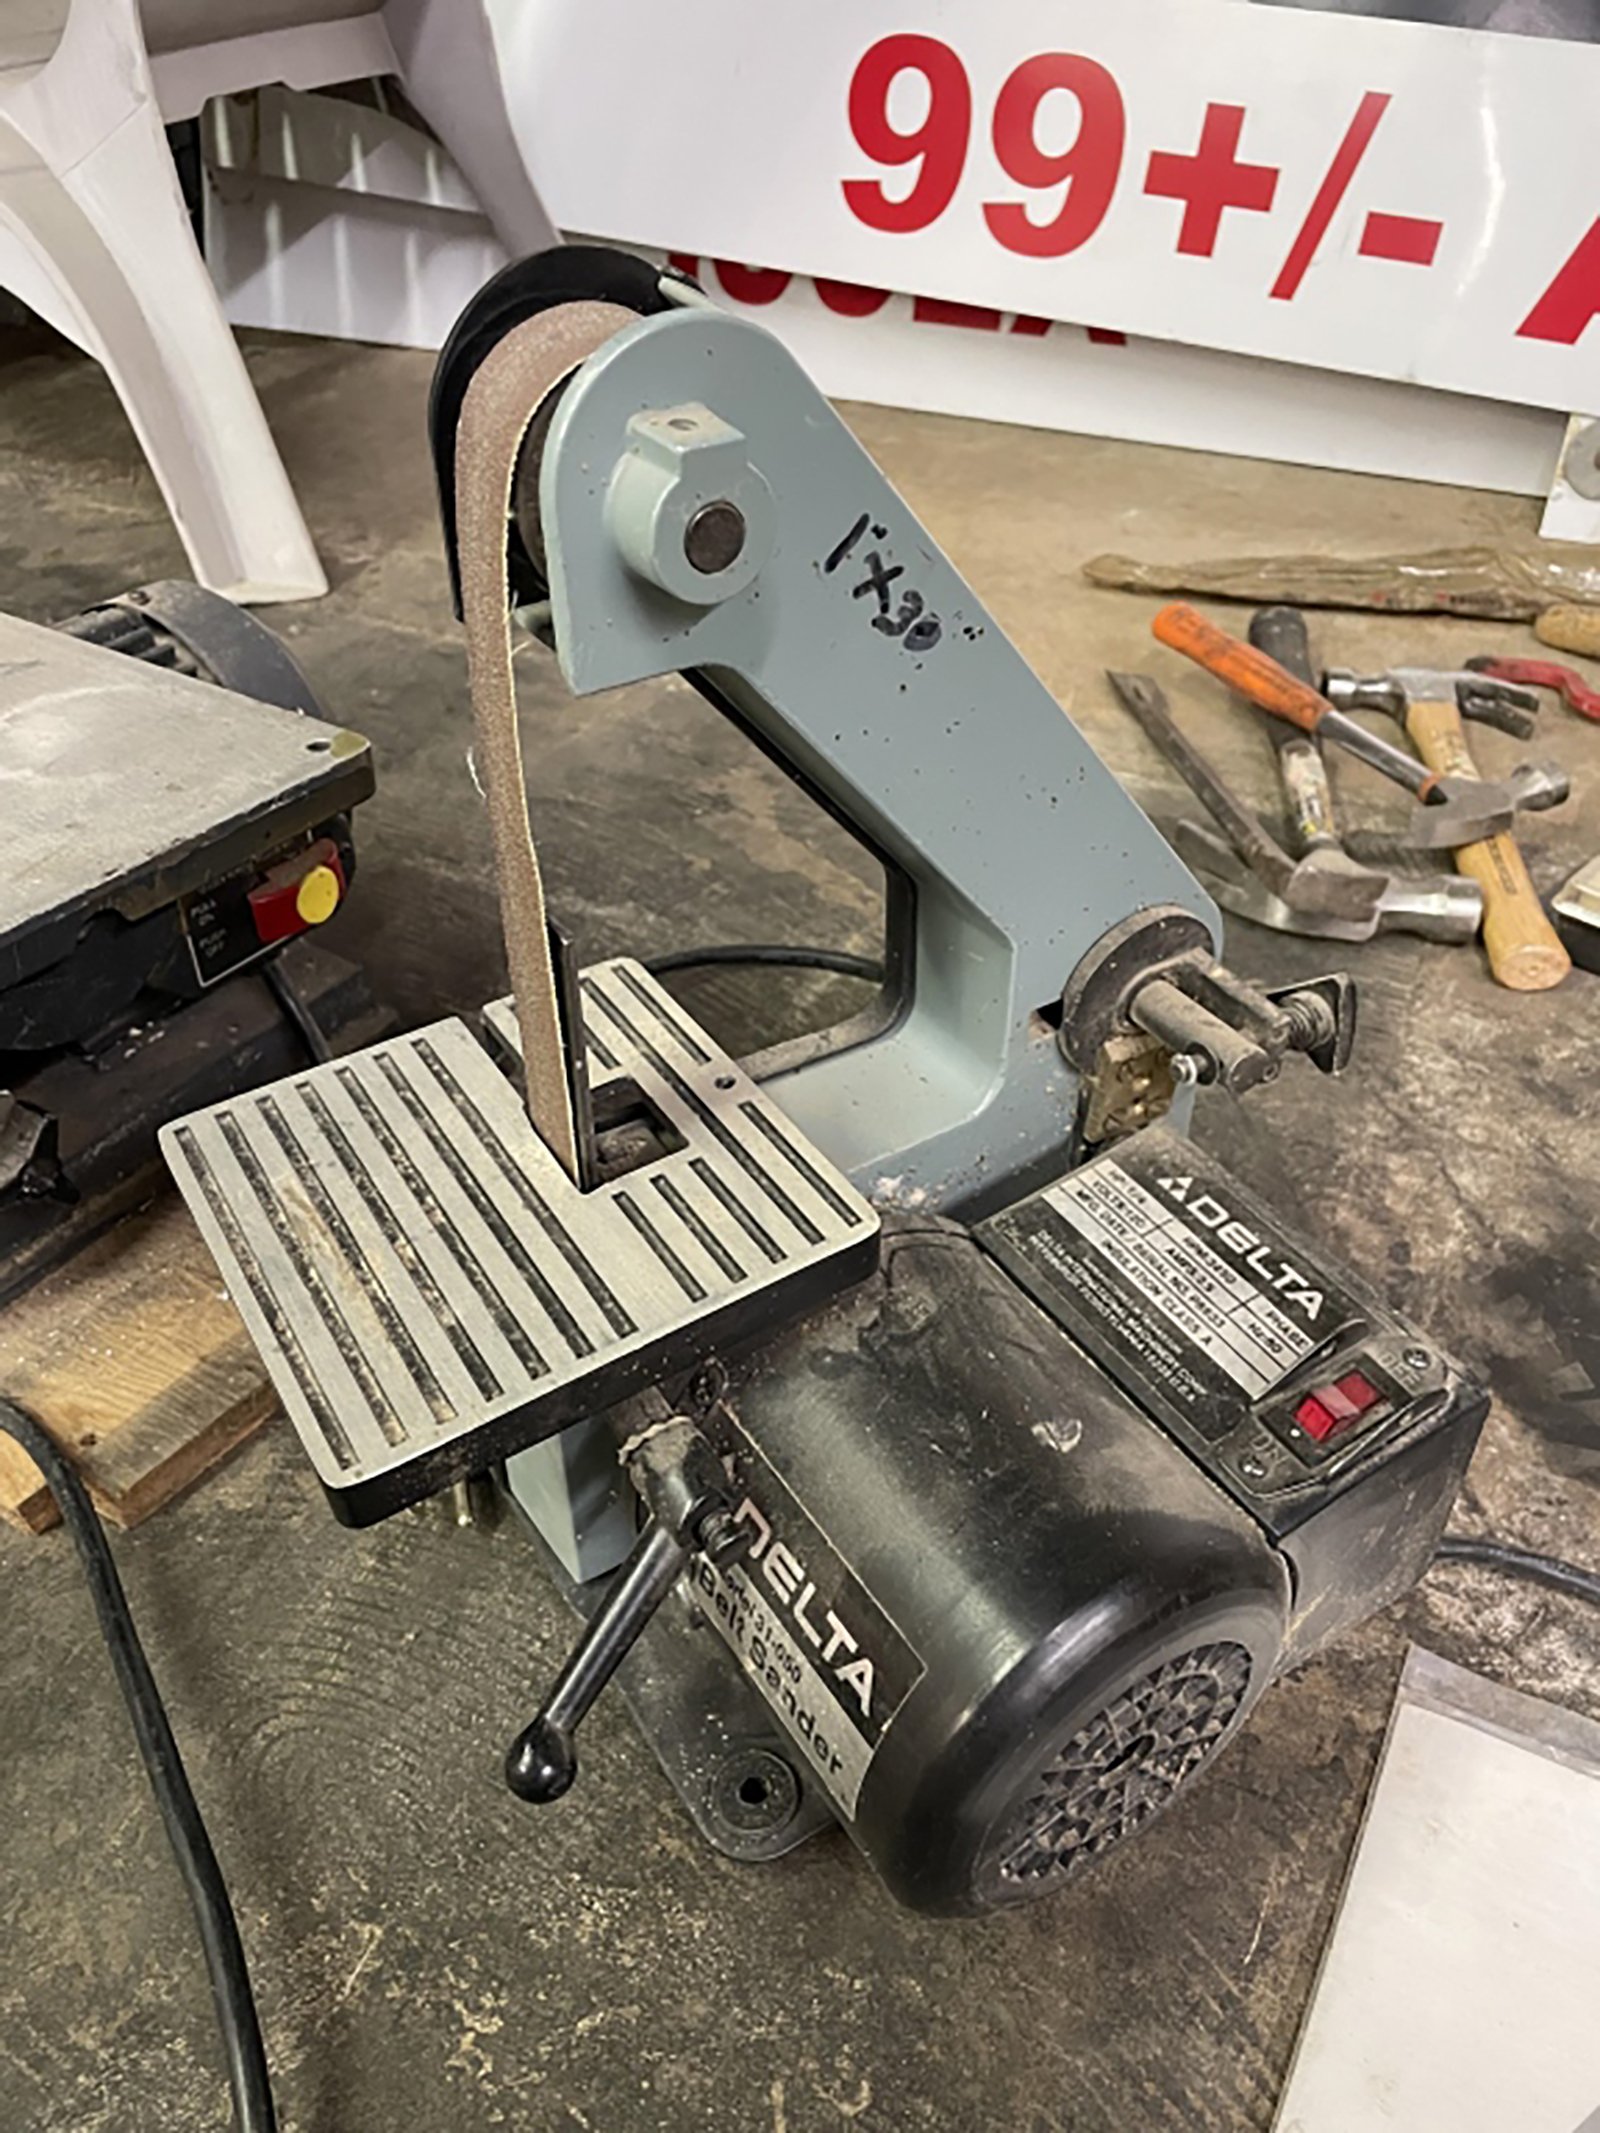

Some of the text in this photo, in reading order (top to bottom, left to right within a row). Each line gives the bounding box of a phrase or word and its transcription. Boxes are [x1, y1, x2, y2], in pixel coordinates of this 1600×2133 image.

[841, 32, 1443, 300] 99+/-
[1186, 1195, 1322, 1320] DELTA
[696, 1564, 844, 1775] Belt Sander
[753, 1617, 803, 1684] 31-050
